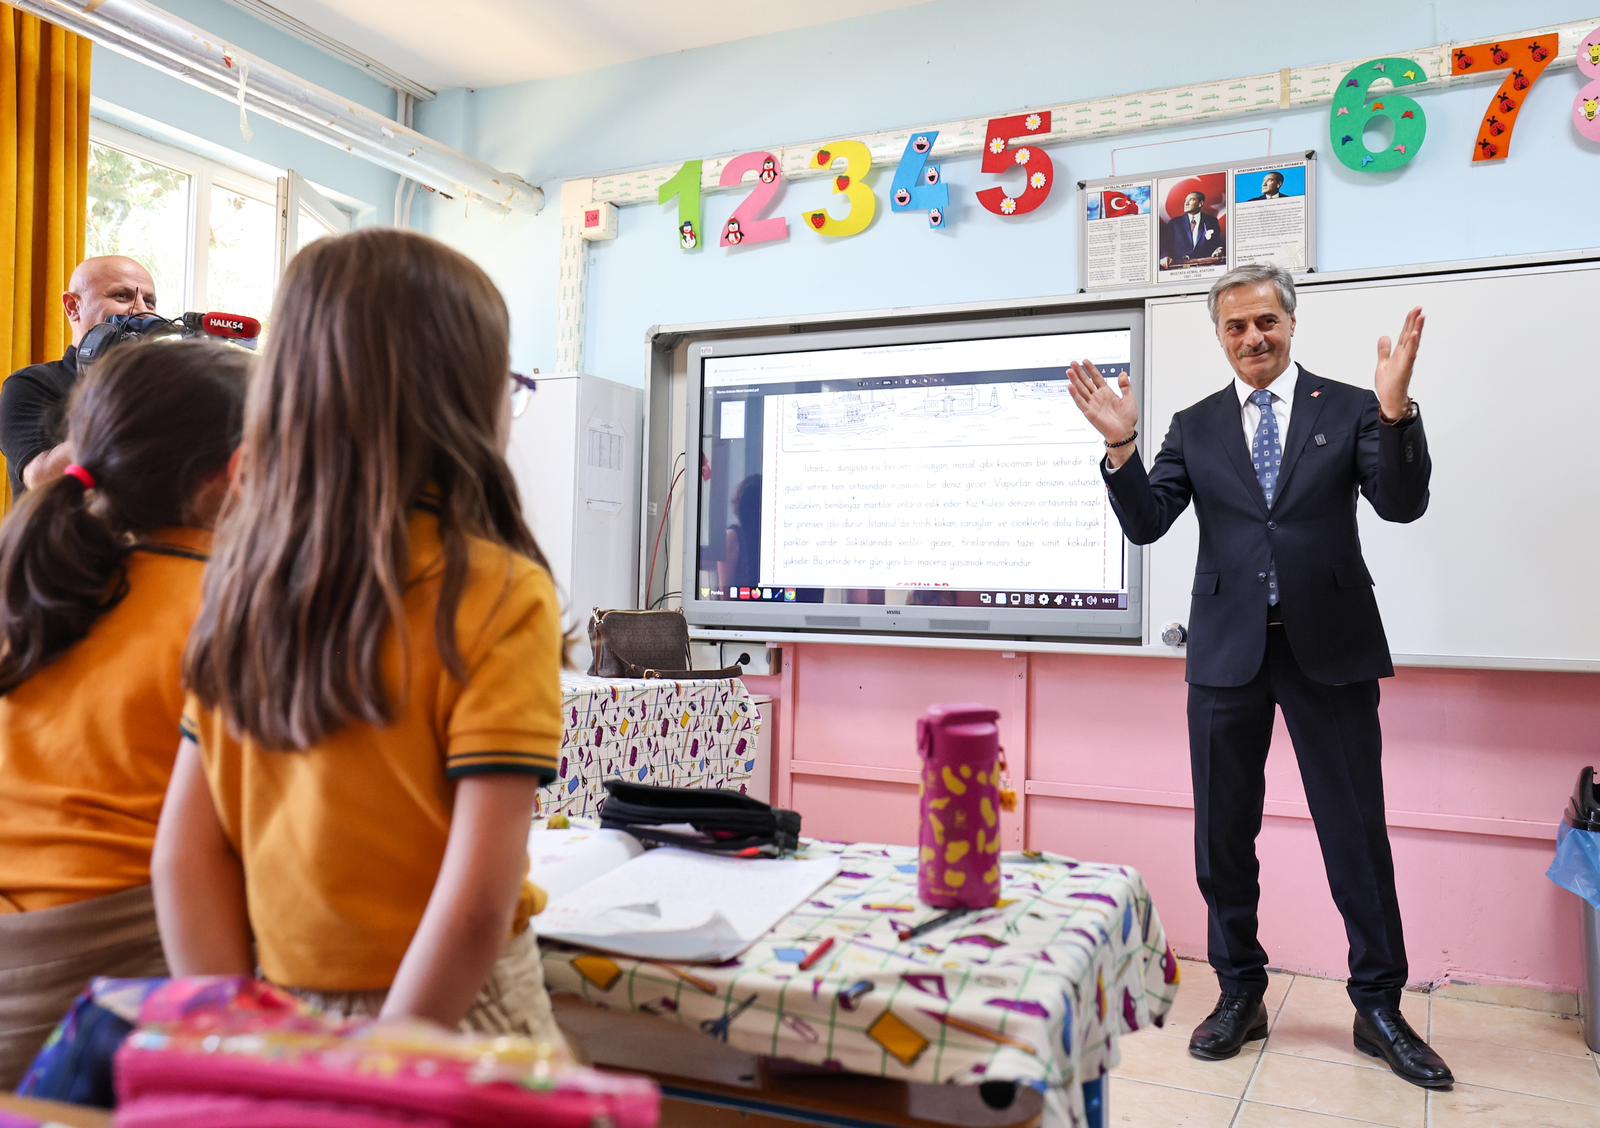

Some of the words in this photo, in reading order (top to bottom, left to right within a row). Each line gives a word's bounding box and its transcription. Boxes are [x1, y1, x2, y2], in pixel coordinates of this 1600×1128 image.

[659, 160, 702, 249] 1
[720, 152, 788, 247] 2
[802, 140, 876, 237] 3
[890, 130, 949, 229] 4
[976, 111, 1053, 216] 5
[1330, 58, 1427, 173] 6
[1452, 32, 1559, 162] 7
[210, 318, 243, 330] HALK54
